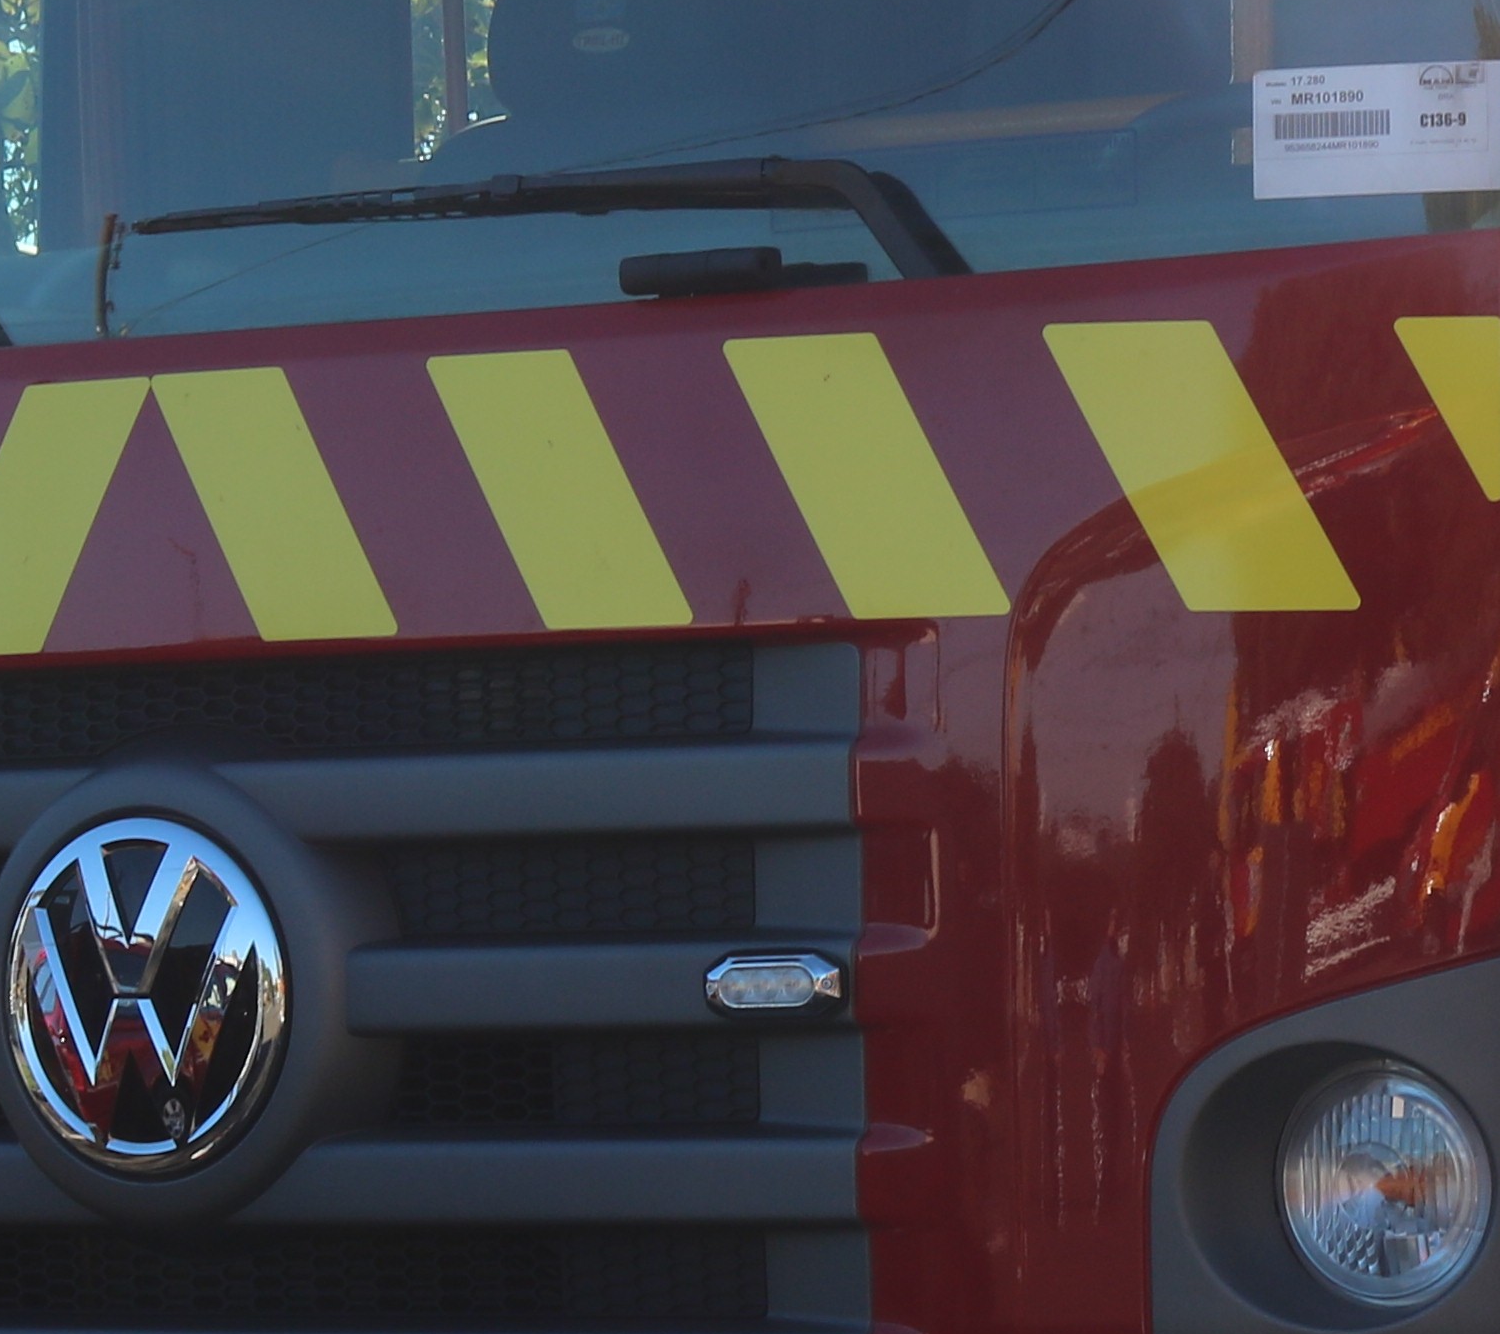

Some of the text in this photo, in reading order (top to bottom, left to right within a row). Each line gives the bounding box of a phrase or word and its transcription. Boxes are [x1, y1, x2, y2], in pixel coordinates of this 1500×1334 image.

[1291, 74, 1326, 87] 17.280
[1291, 90, 1364, 106] MR101890
[1420, 112, 1467, 128] C136-9
